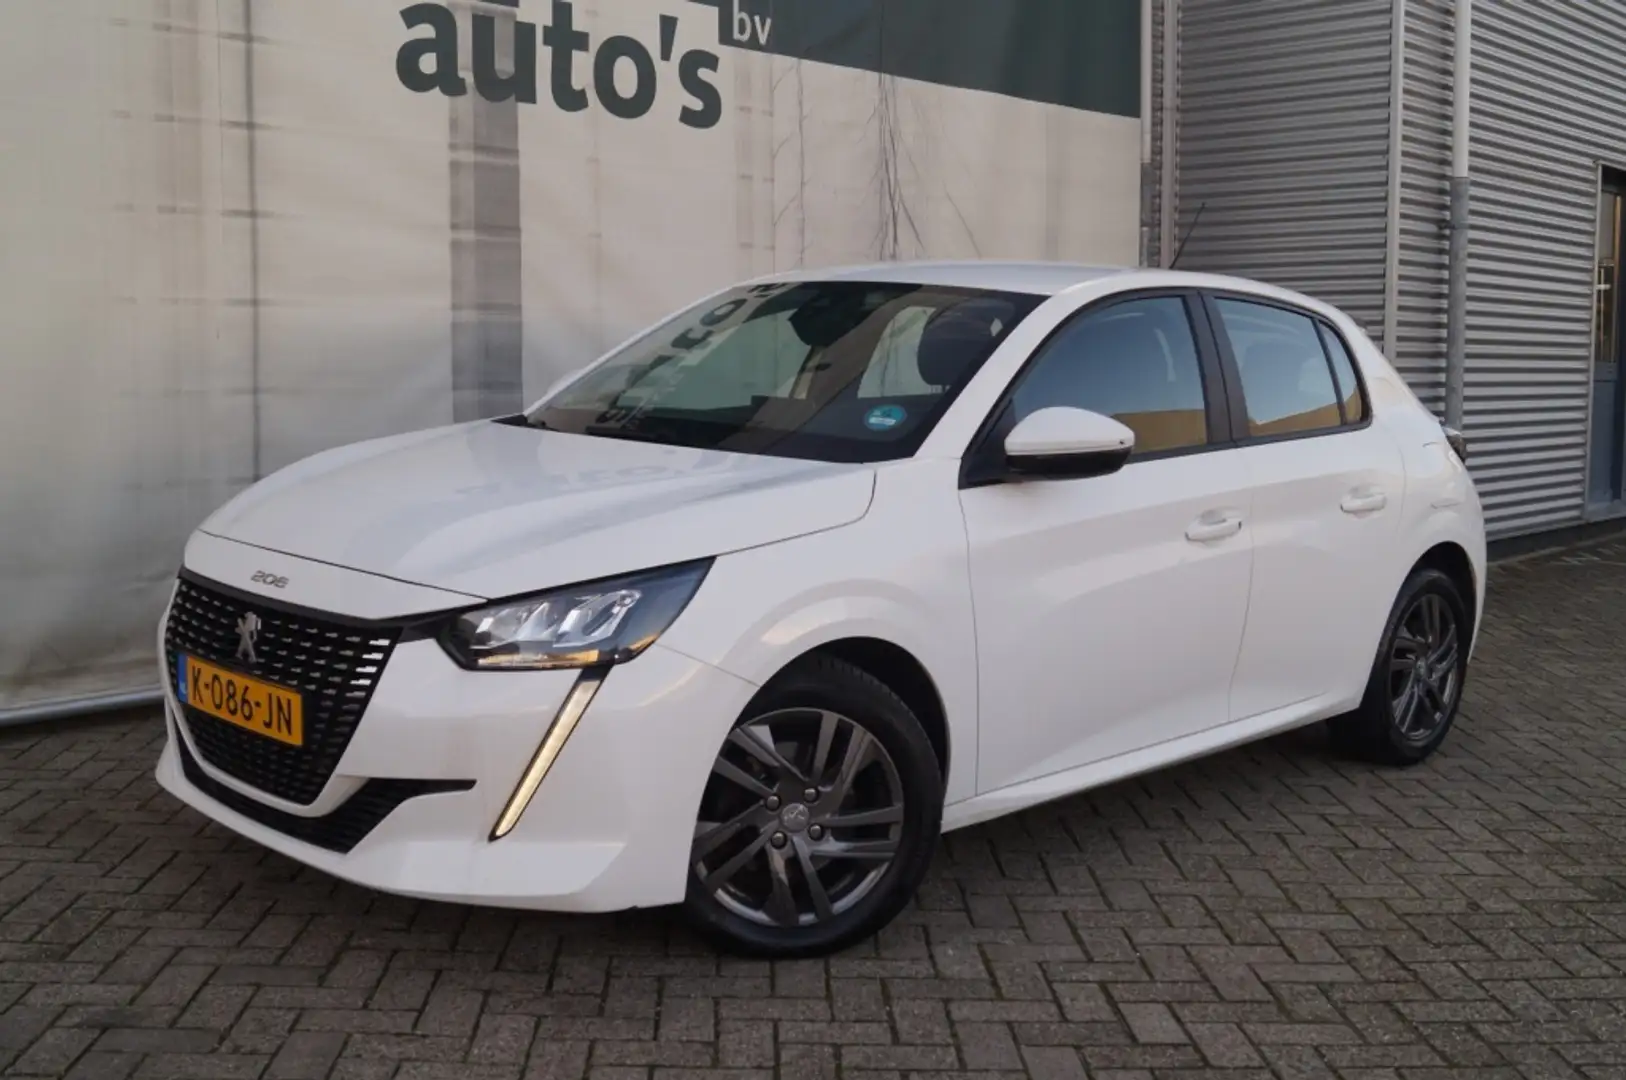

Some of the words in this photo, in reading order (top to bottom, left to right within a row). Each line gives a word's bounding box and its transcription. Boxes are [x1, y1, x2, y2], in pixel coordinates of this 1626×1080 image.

[733, 0, 771, 45] bv
[396, 0, 722, 129] auto's
[192, 665, 292, 736] K-086-JN
